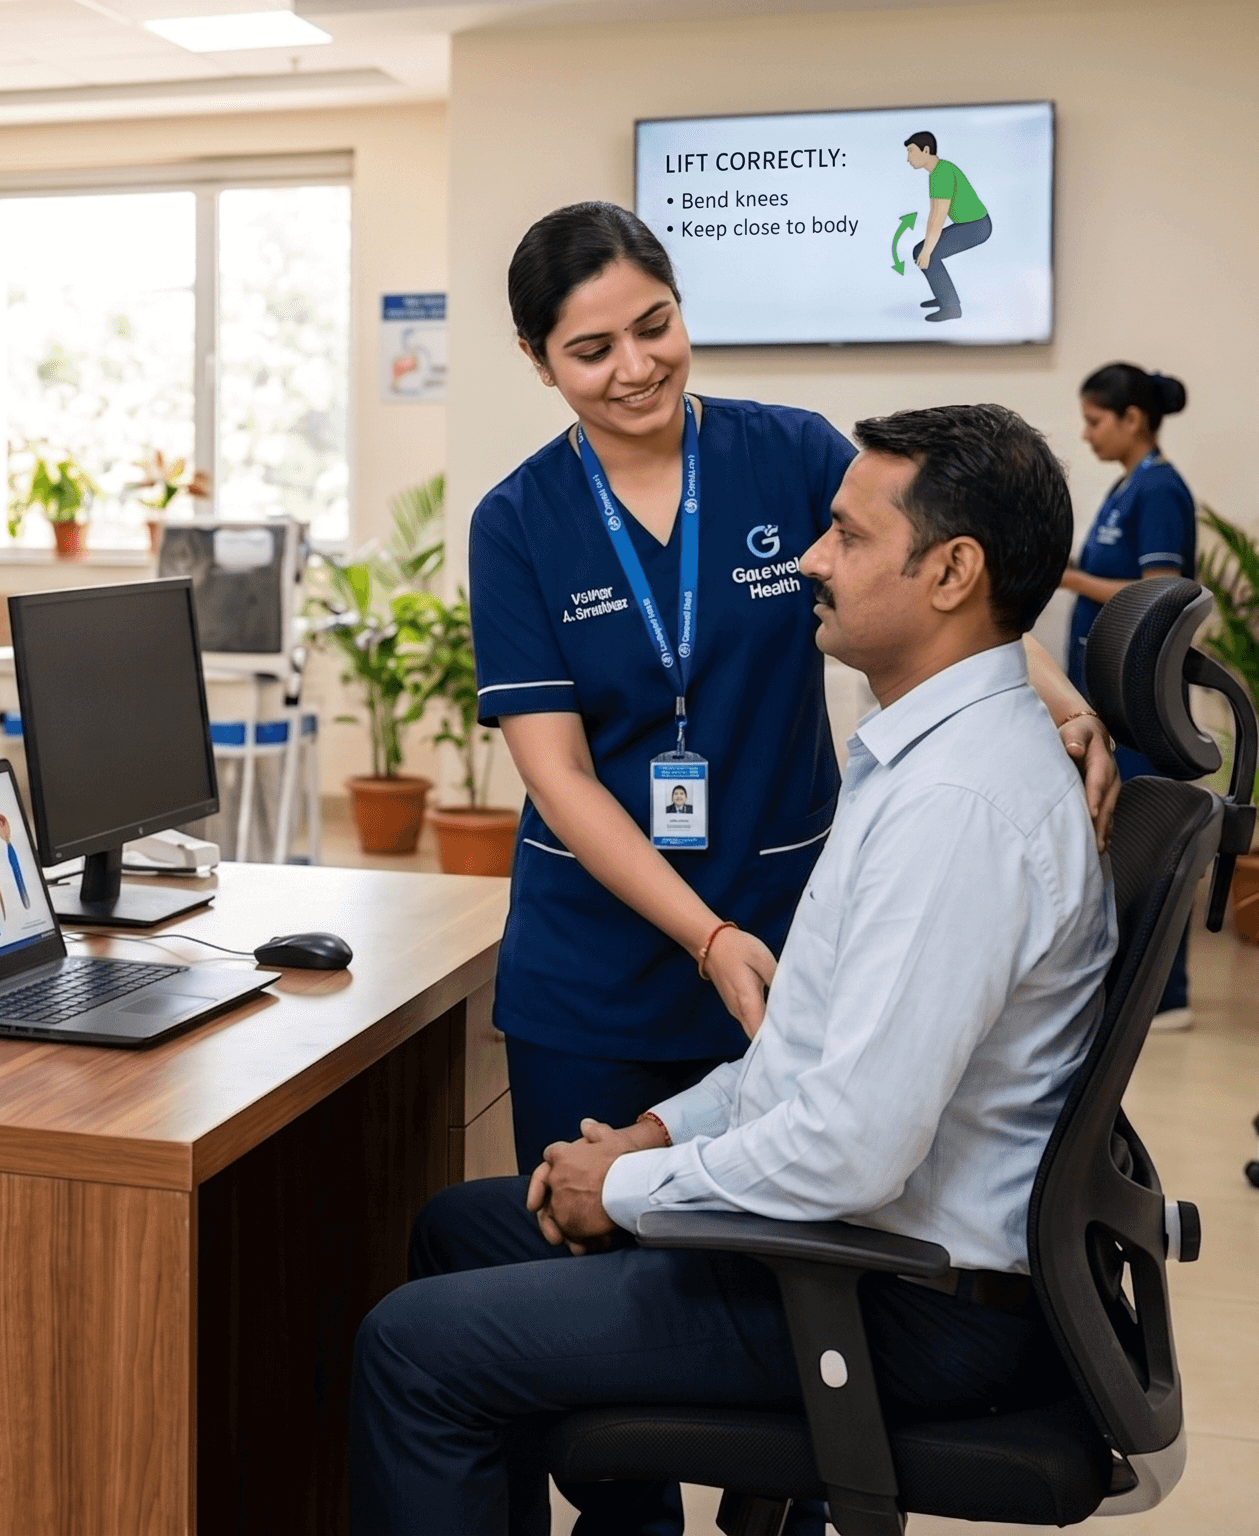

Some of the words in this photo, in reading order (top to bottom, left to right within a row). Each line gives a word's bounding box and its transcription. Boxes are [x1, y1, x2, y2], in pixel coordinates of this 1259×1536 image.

[667, 154, 708, 173] LIFT
[716, 149, 845, 171] CORRECTLY:
[683, 191, 728, 209] Bend
[736, 190, 788, 207] knees
[683, 221, 726, 240] Keep
[734, 219, 780, 236] close
[786, 220, 805, 234] to
[813, 215, 858, 236] body
[749, 577, 801, 599] Health
